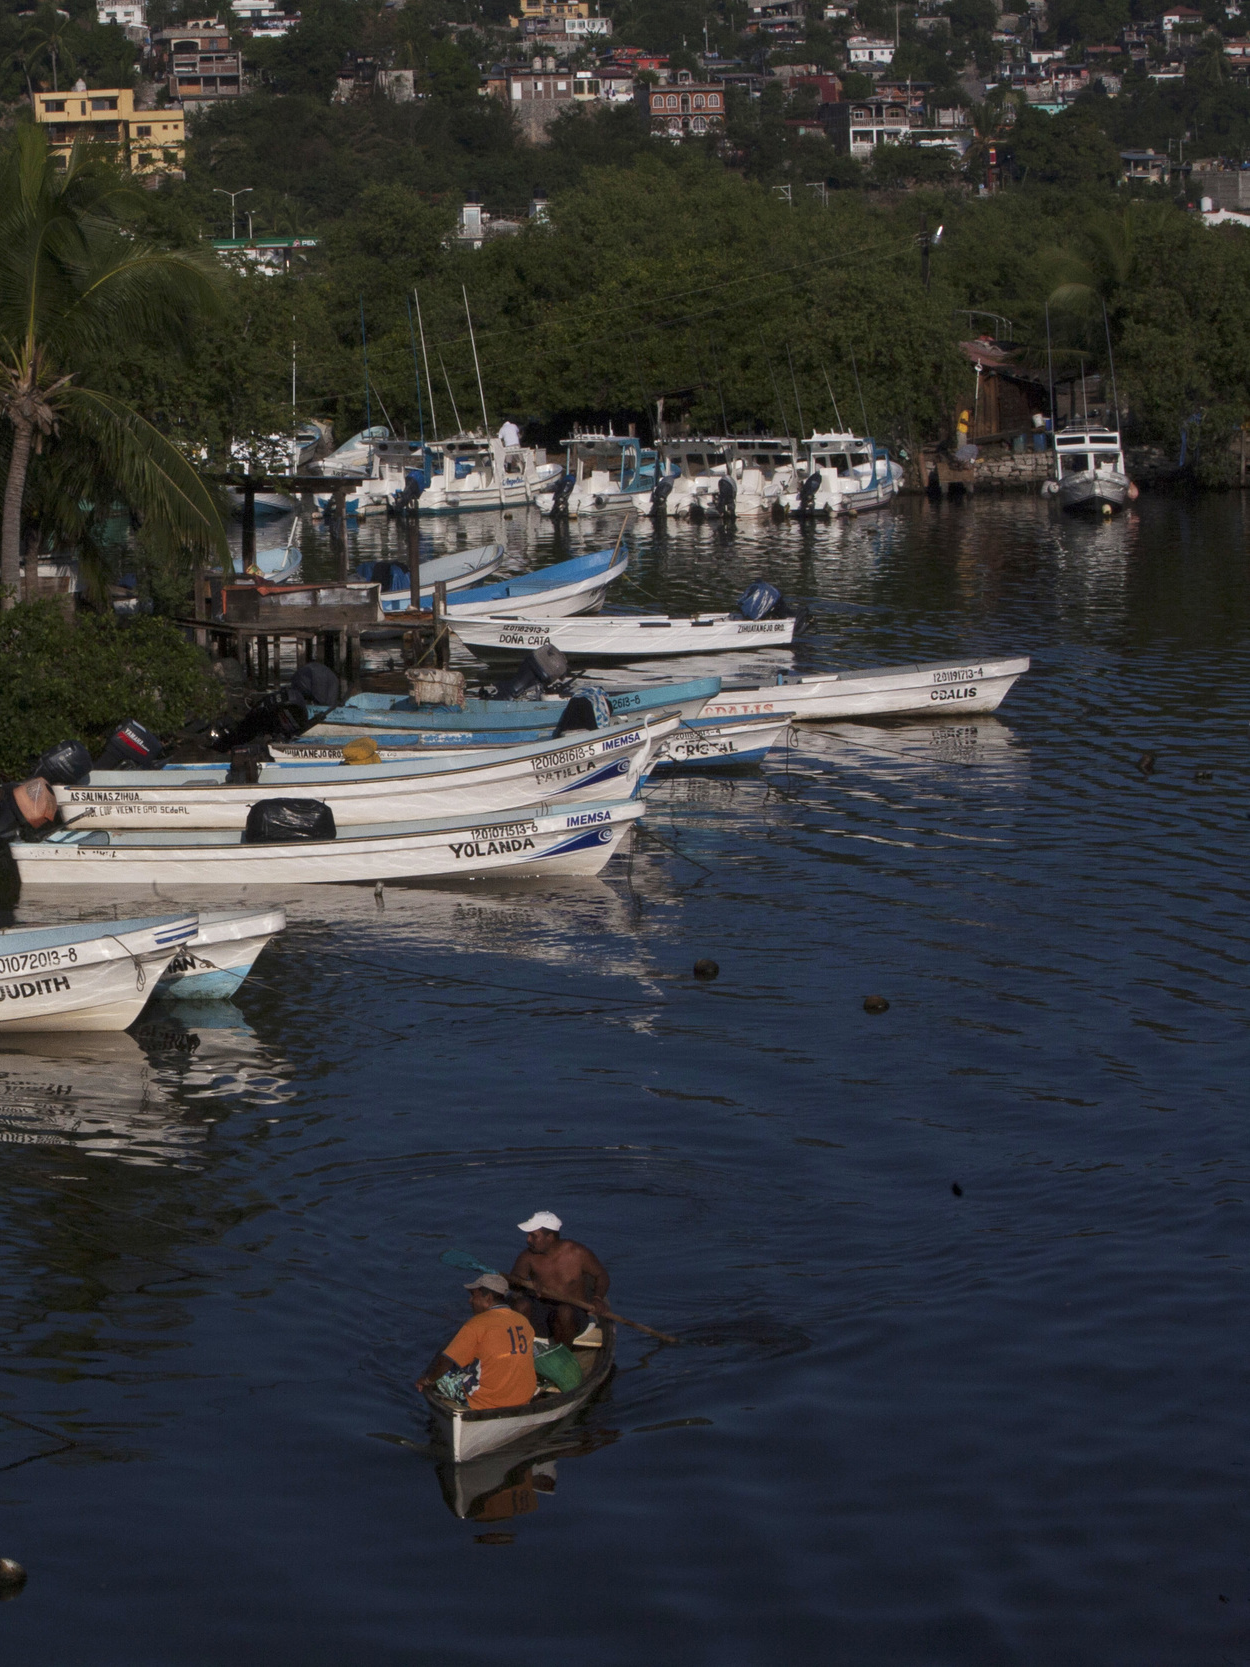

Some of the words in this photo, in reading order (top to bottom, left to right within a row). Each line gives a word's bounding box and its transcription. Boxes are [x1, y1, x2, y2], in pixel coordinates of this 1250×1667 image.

[499, 633, 524, 644] DOÑA
[527, 635, 551, 646] CATA
[602, 732, 641, 751] IMEMSA
[531, 745, 595, 770] 1201081613-5
[81, 792, 113, 802] SALINAS
[116, 806, 141, 814] VICENTE
[567, 811, 611, 828] IMEMSA
[470, 824, 538, 841] 1201071513-6
[448, 838, 535, 859] YOLANDA
[507, 1326, 528, 1355] 15
